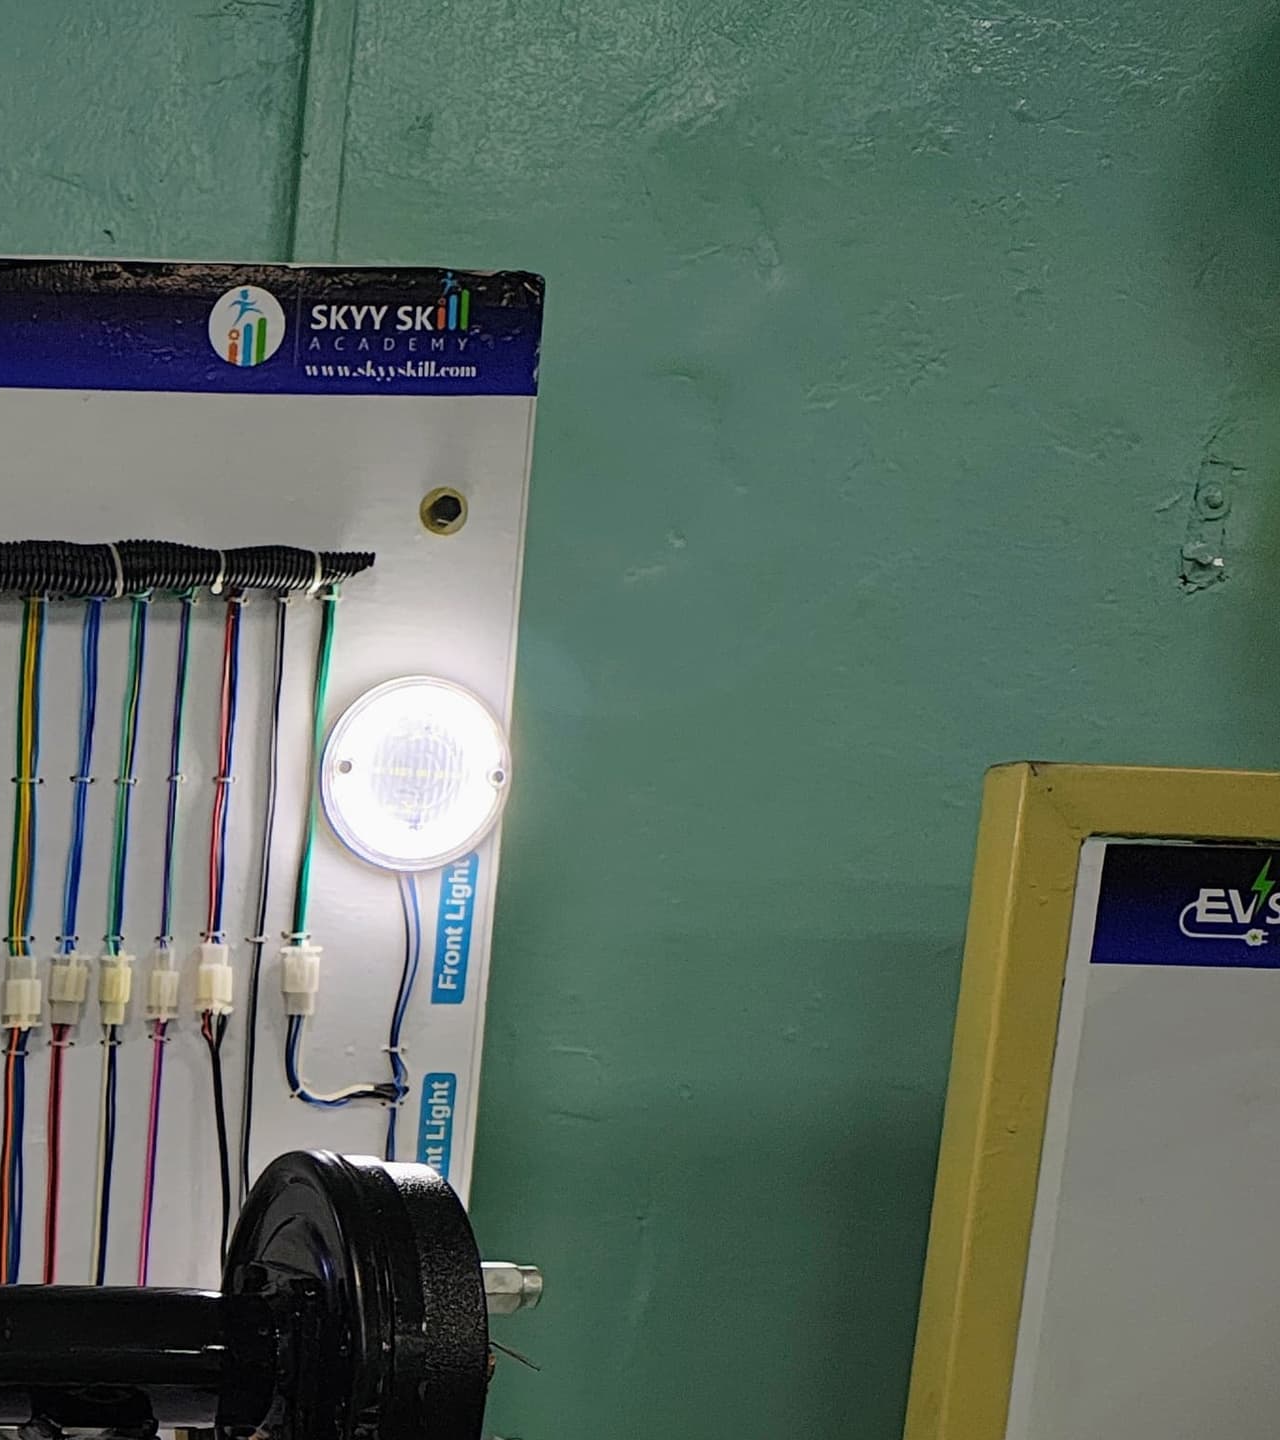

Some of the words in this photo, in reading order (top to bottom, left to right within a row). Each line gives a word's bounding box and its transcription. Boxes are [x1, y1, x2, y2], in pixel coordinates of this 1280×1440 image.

[310, 304, 390, 331] SKYY
[308, 336, 469, 352] ACADEMY
[304, 360, 478, 383] www.skyyskill.com
[437, 926, 464, 990] Front
[425, 1080, 452, 1140] Light
